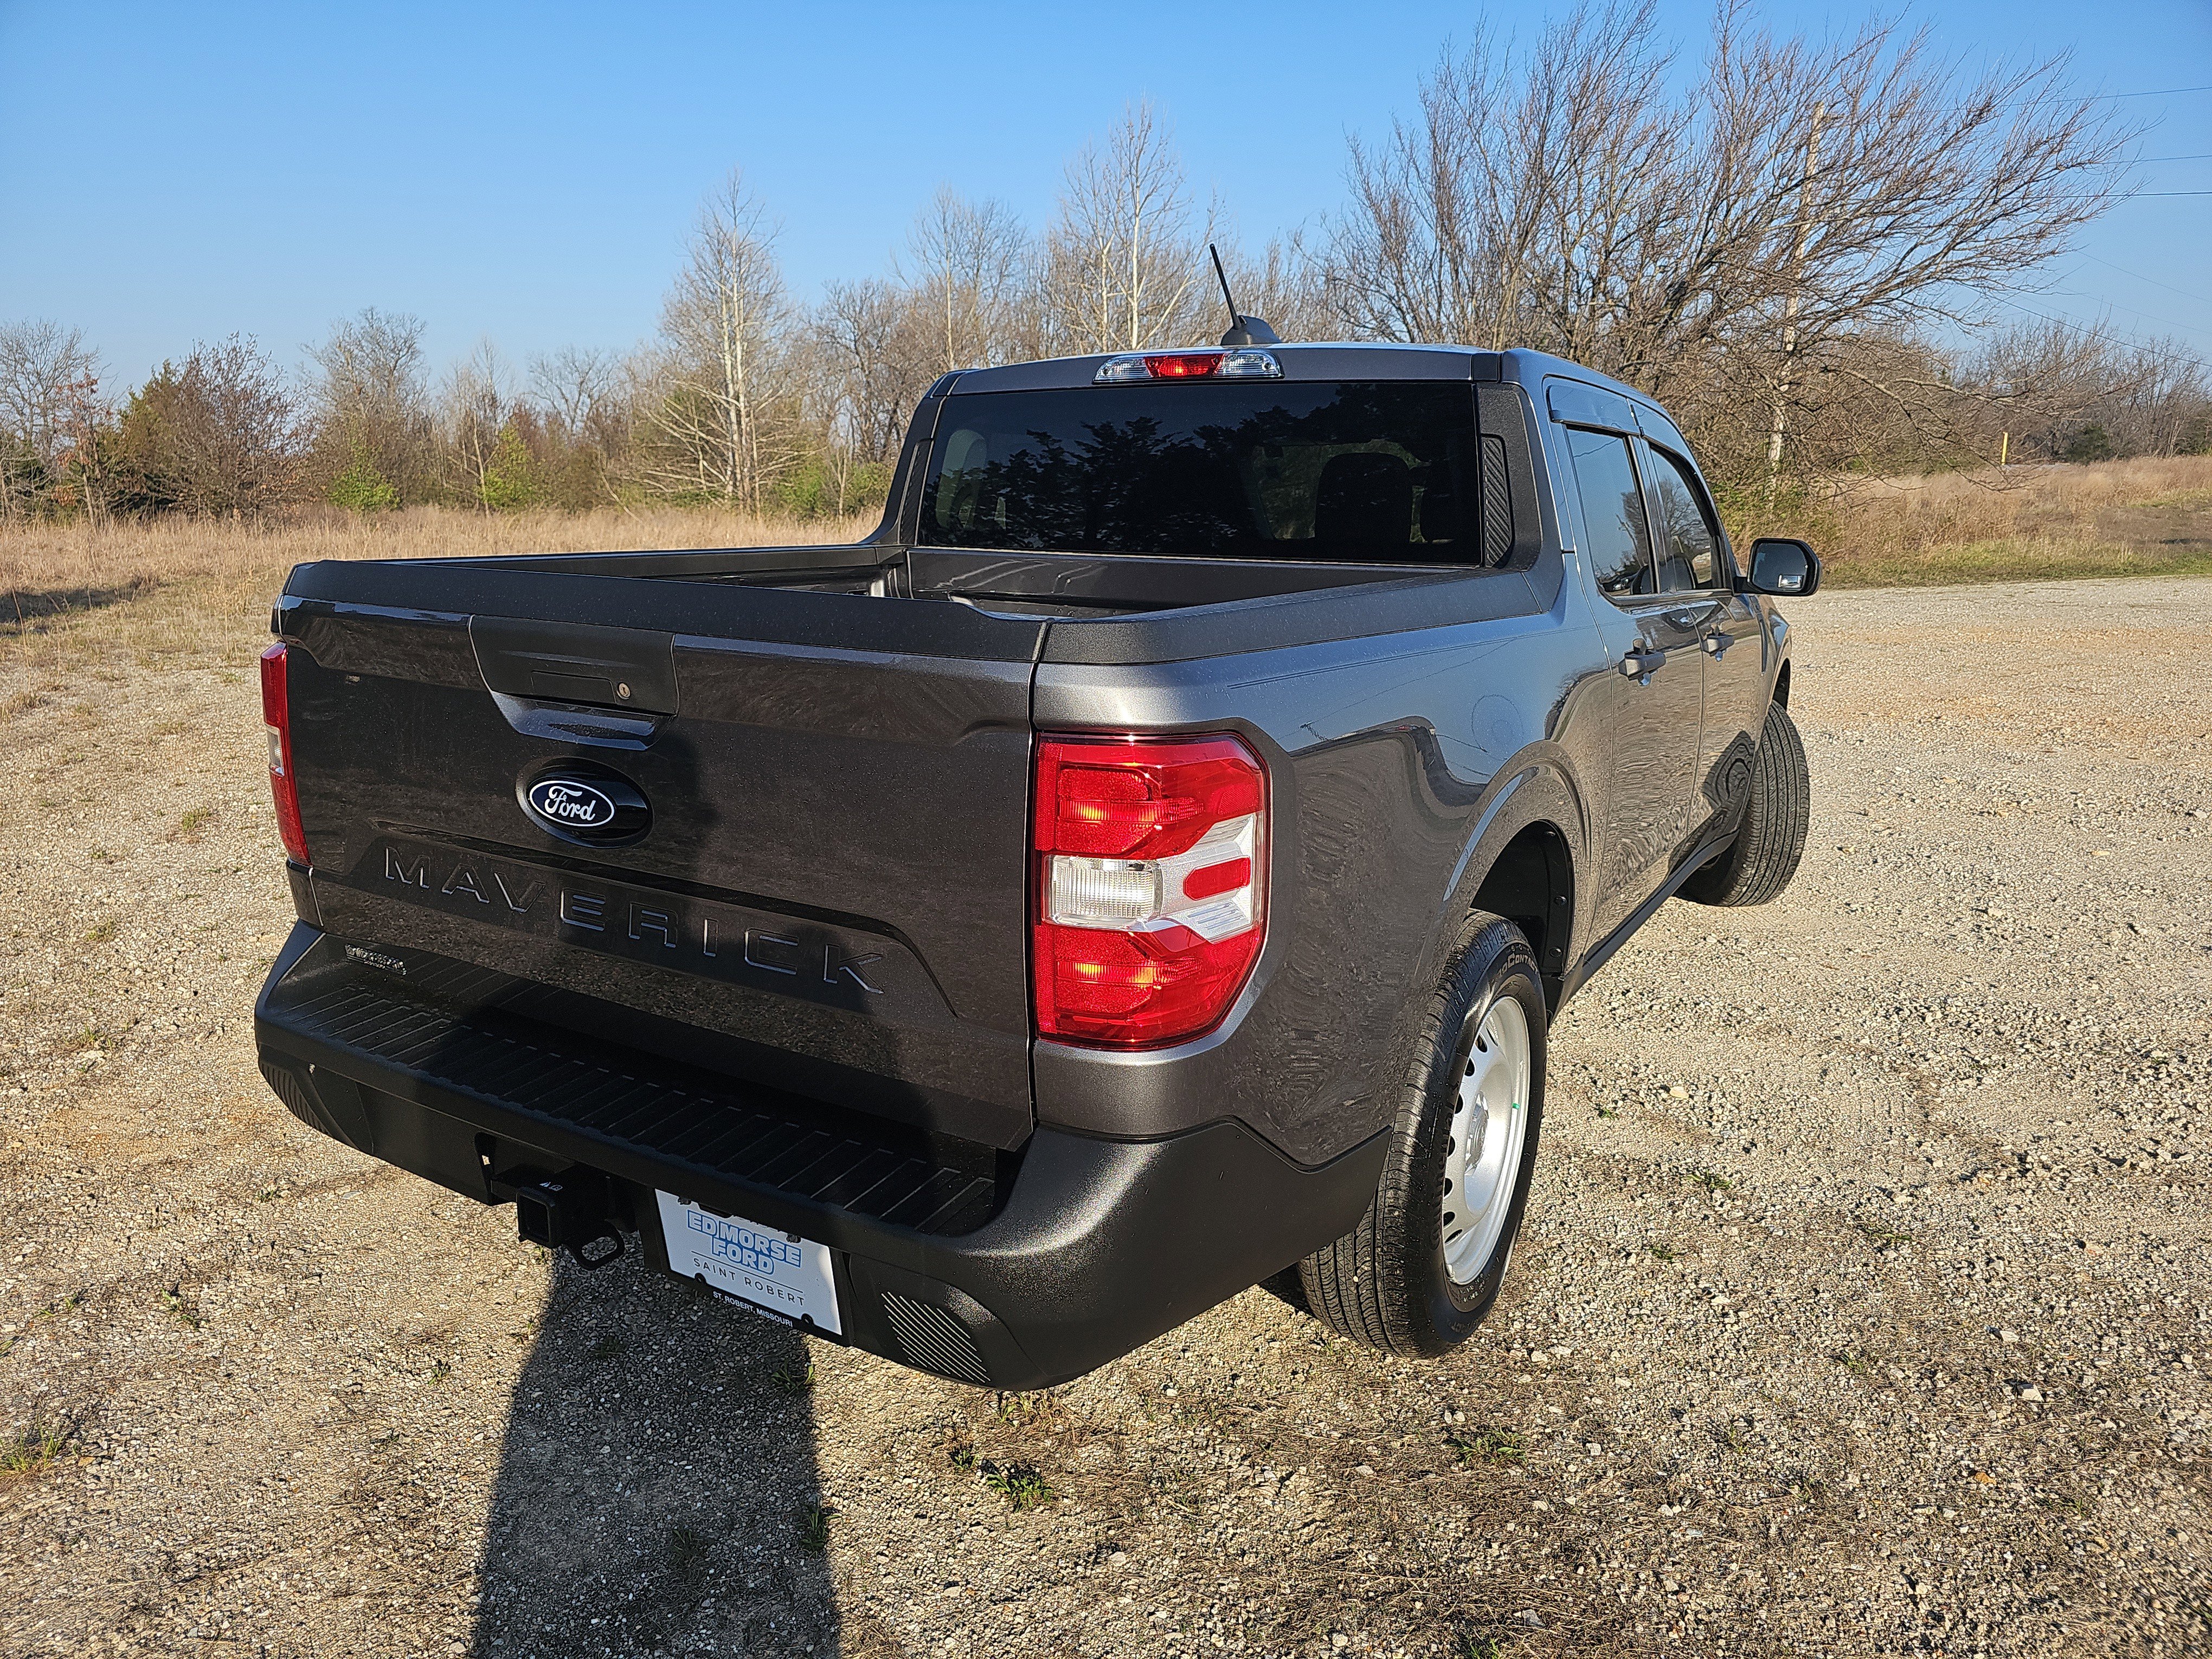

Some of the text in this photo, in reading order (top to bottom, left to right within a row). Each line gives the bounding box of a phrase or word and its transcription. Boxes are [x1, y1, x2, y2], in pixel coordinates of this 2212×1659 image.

[544, 786, 596, 821] Ford
[384, 846, 885, 994] MAVERICK
[687, 1209, 801, 1268] ED MORSE
[711, 1237, 775, 1275] FORD
[693, 1257, 805, 1306] SAINT ROBERT
[712, 1291, 793, 1328] ST. ROBERT, MISSOURI
